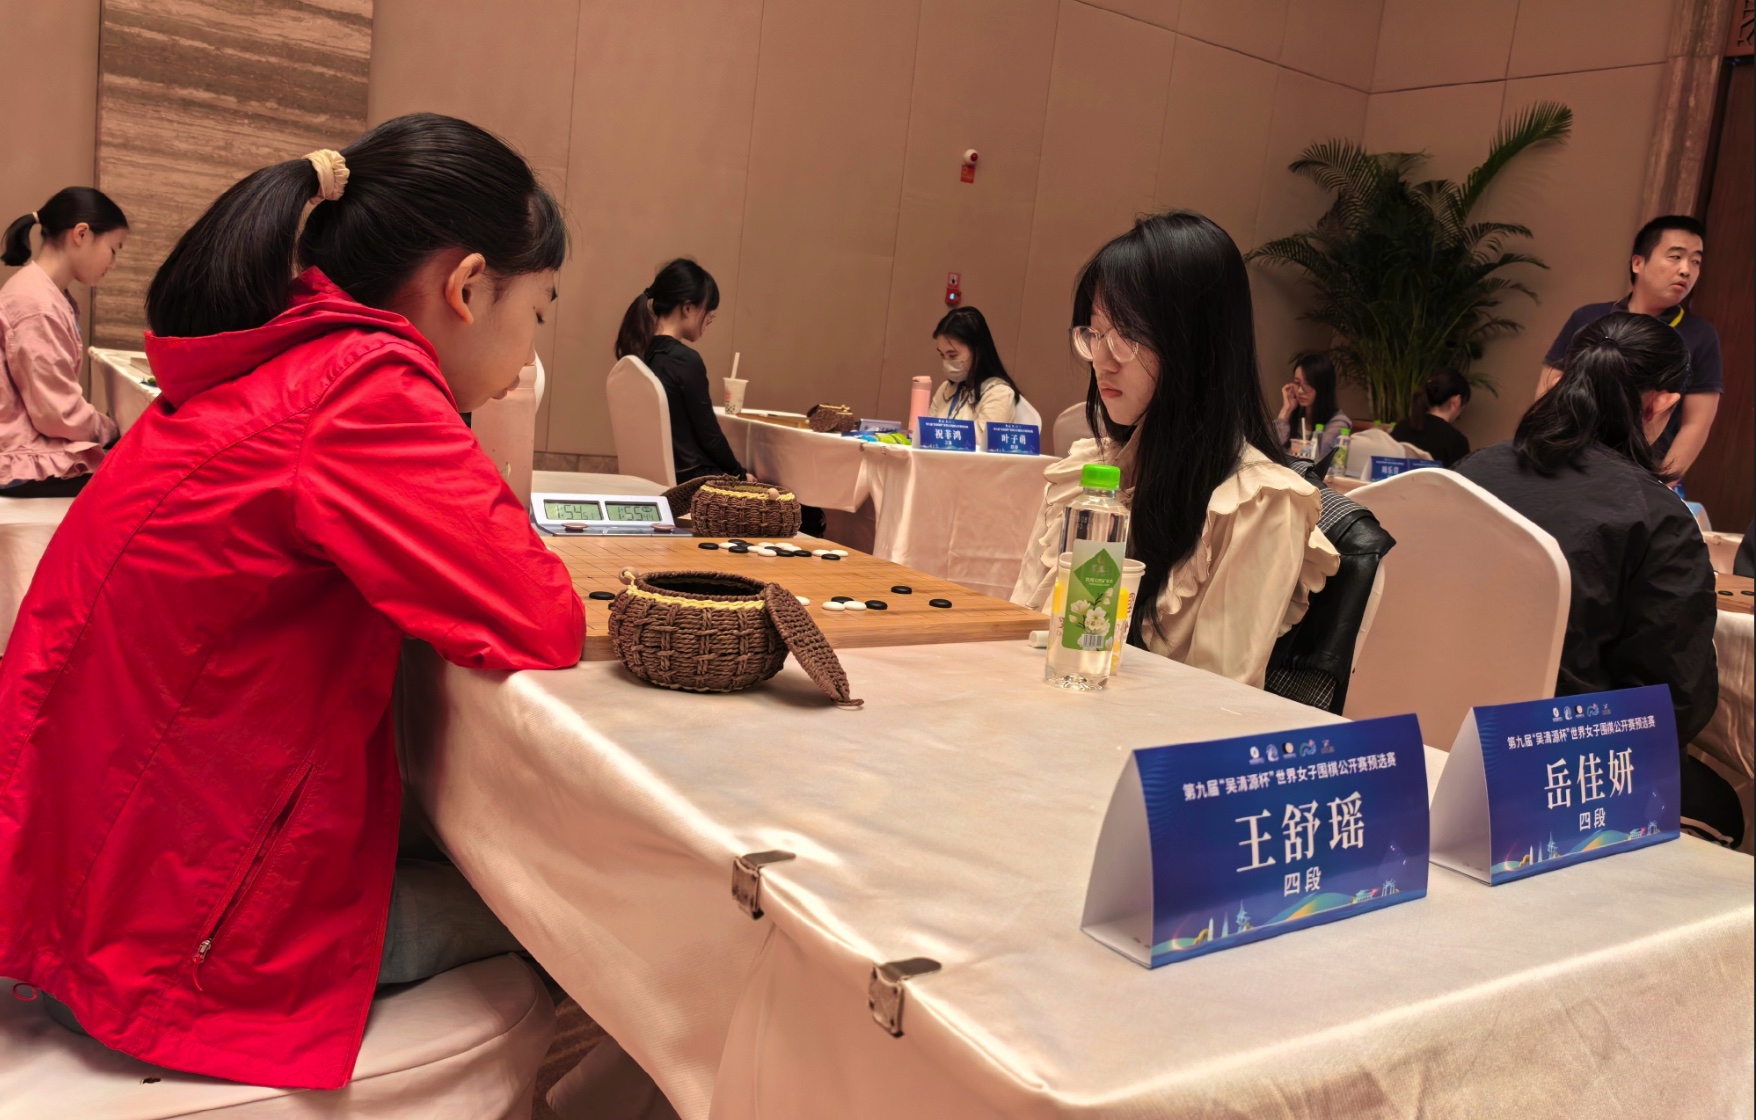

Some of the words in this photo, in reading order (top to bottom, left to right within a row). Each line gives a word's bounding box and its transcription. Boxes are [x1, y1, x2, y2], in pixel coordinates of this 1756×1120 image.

[1544, 747, 1635, 810] 岳佳妍
[1234, 791, 1365, 873] 王舒瑶
[1579, 807, 1606, 832] 四段
[1284, 866, 1322, 897] 四段
